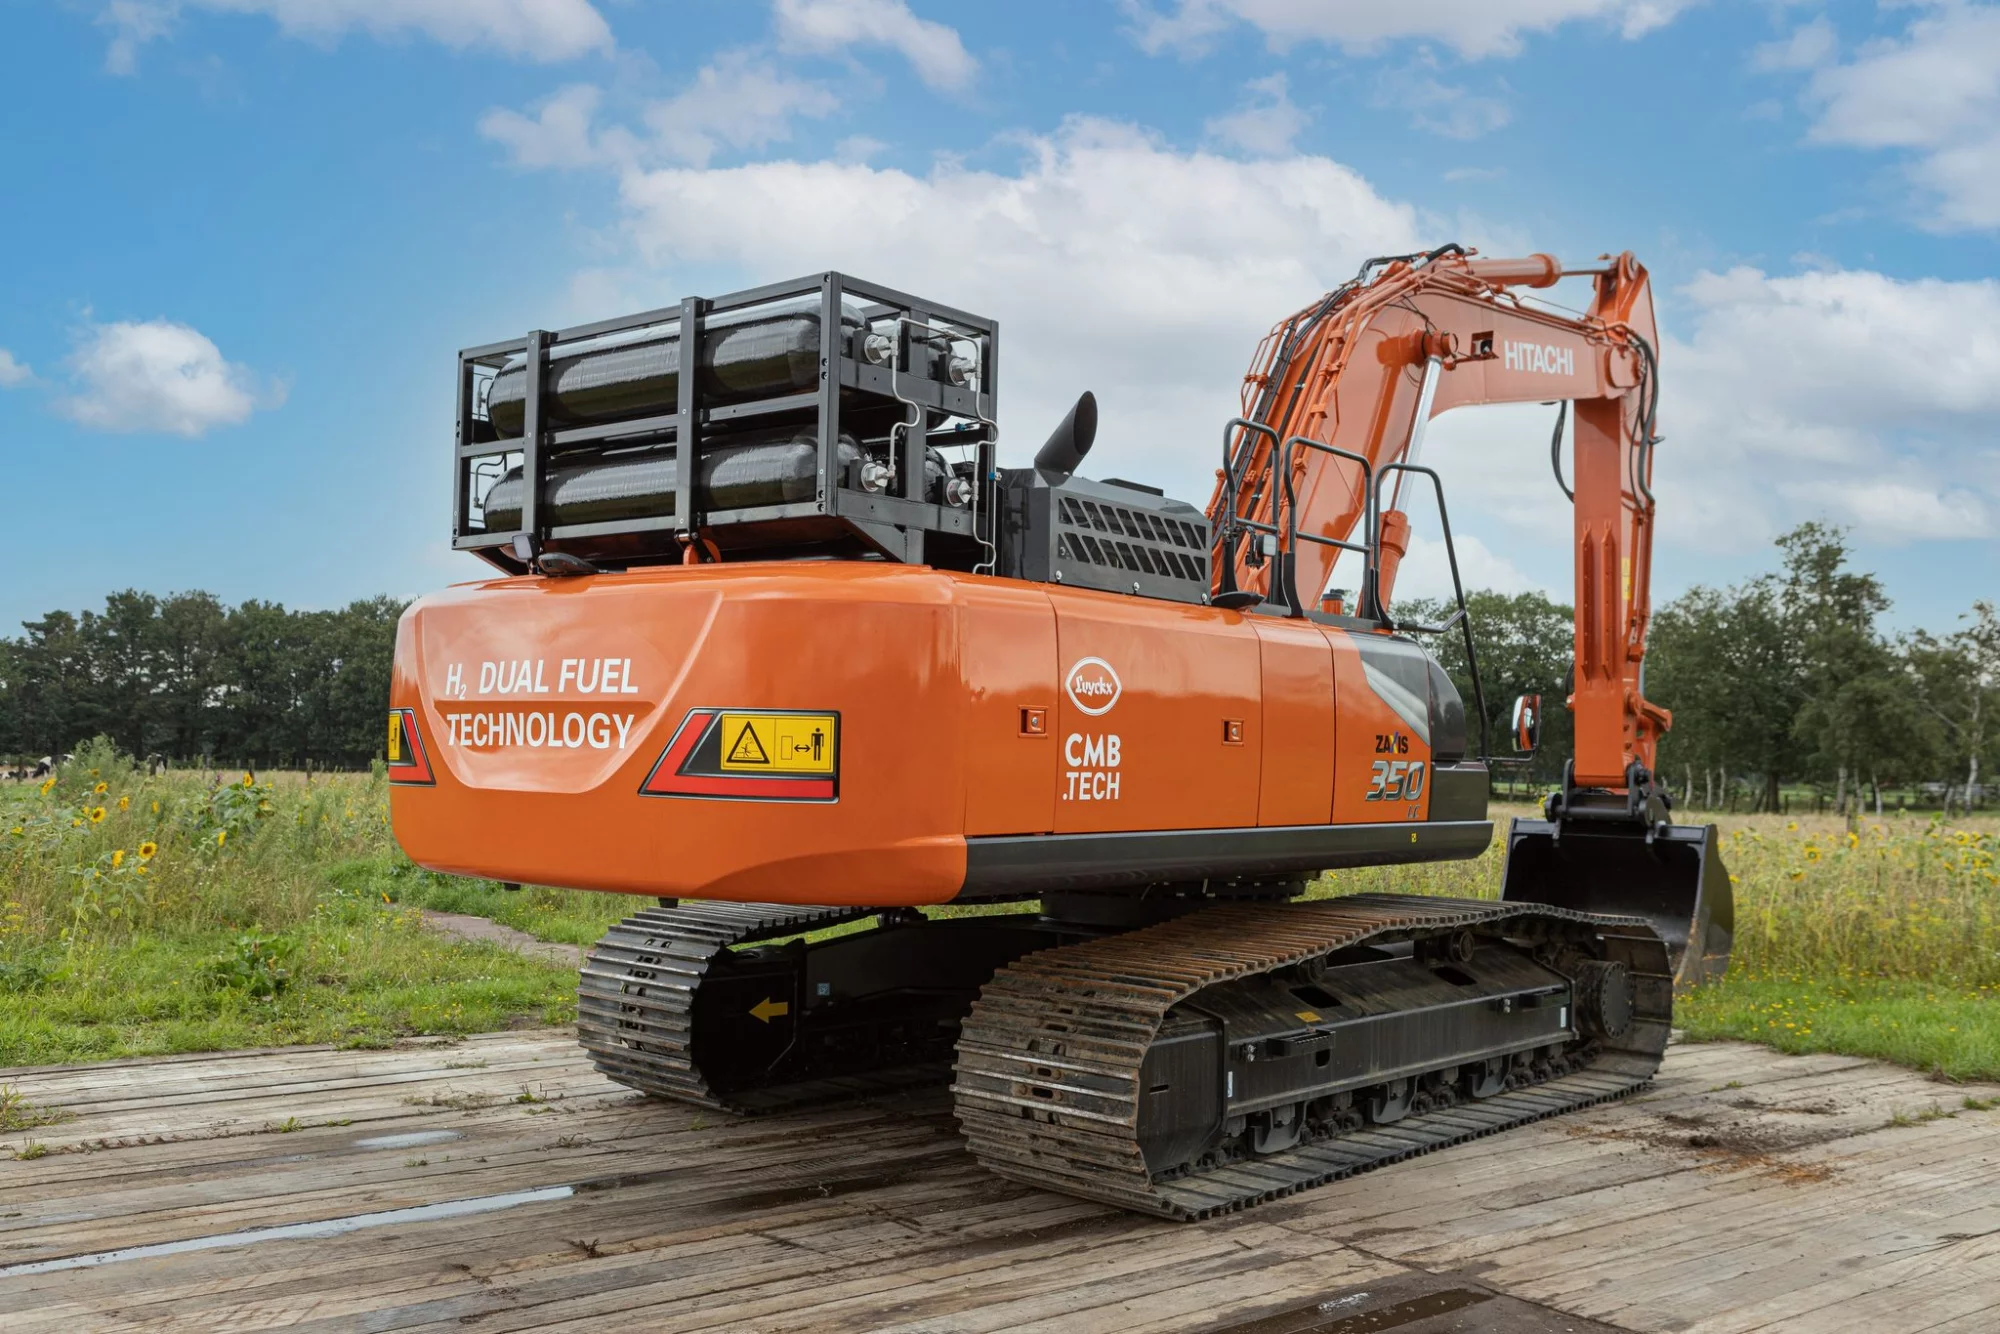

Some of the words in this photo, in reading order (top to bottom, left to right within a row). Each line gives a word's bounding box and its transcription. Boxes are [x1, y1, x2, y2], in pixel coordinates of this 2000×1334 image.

[1504, 340, 1574, 376] HITACHI
[479, 659, 549, 694] DUAL
[558, 658, 639, 694] FUEL
[1075, 675, 1113, 697] Luyckx
[447, 712, 635, 749] TECHNOLOGY
[1376, 732, 1408, 754] ZAXIS
[1065, 733, 1121, 767] CMB
[1062, 772, 1120, 800] .TECH
[1366, 760, 1426, 801] 350
